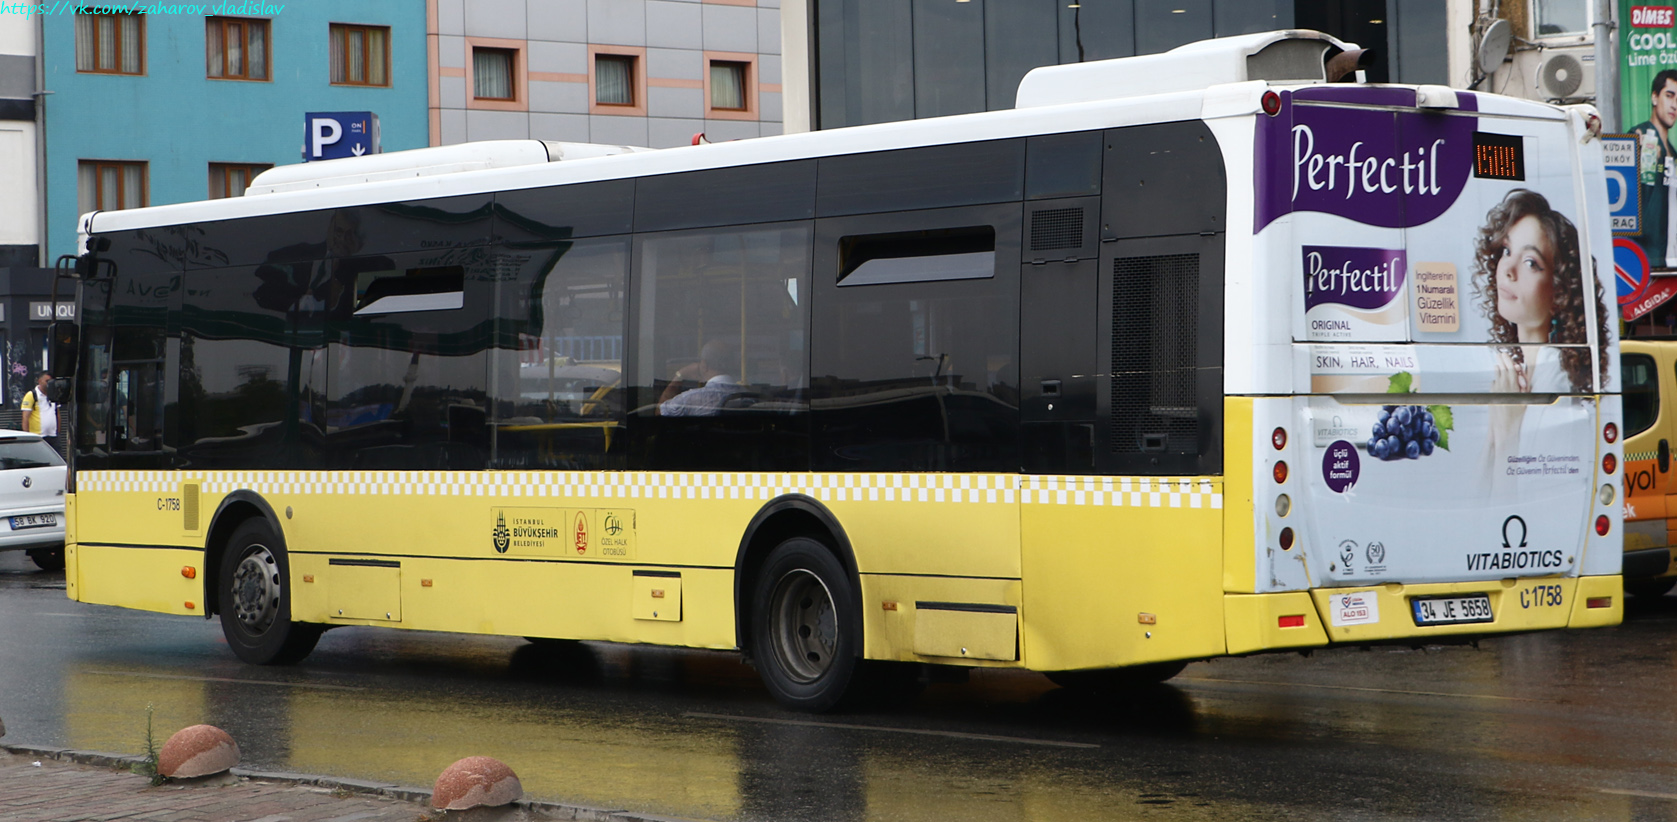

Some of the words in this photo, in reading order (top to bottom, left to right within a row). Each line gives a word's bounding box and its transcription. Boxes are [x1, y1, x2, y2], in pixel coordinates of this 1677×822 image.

[1630, 32, 1676, 50] COOL
[1628, 52, 1657, 67] Lime
[312, 118, 342, 157] P
[1306, 251, 1400, 299] Perfectil
[1417, 296, 1456, 309] Güzellik
[1634, 290, 1669, 316] ALGIDA
[1311, 320, 1352, 330] ORIGINAL
[1419, 312, 1456, 324] Vitamini
[1316, 355, 1343, 369] SKIN,
[1351, 356, 1379, 369] HAIR,
[1385, 356, 1414, 368] NAILS
[1317, 428, 1358, 436] VITABIOTICS
[1333, 460, 1349, 469] aktif
[1624, 464, 1656, 498] yol
[157, 497, 180, 511] C-1758
[513, 526, 558, 538] BÜYÜKŞEHİR
[1466, 550, 1563, 571] VITABIOTICS
[1421, 602, 1436, 619] 34
[1443, 601, 1456, 618] JE
[1460, 599, 1489, 617] 5658
